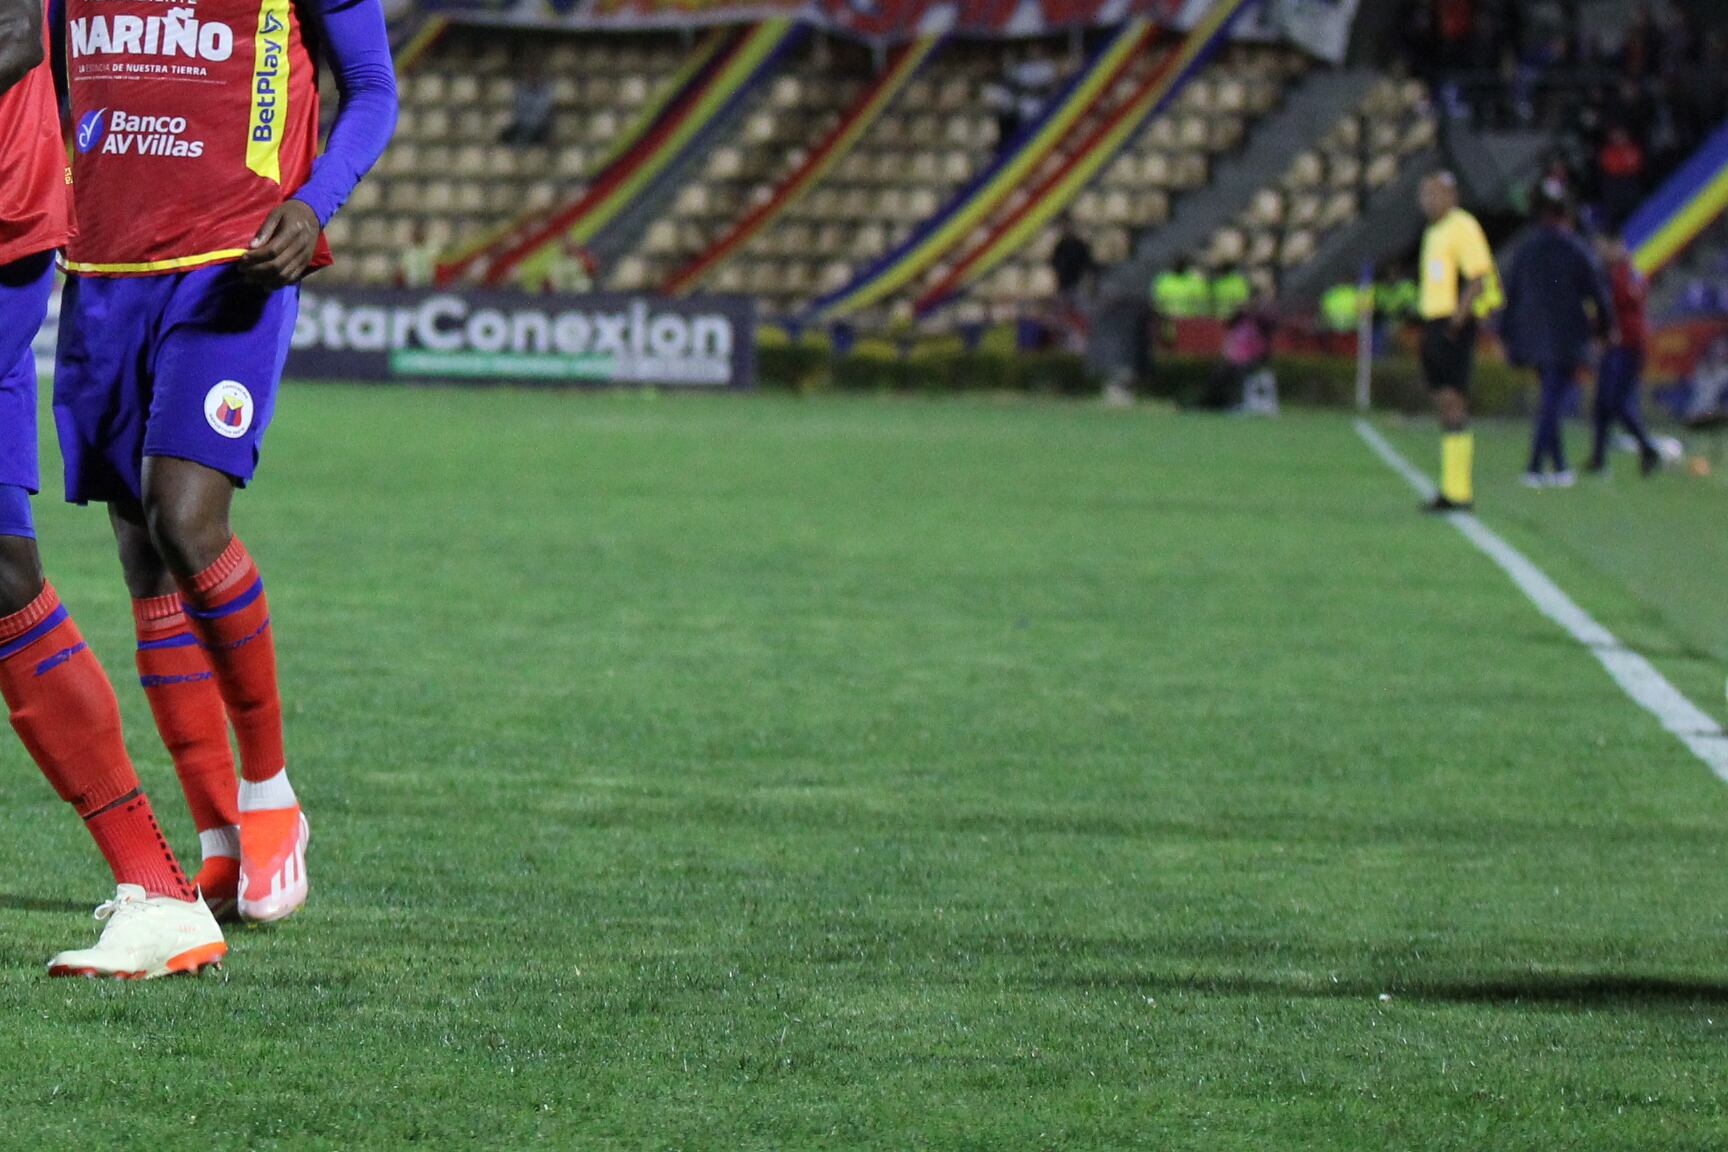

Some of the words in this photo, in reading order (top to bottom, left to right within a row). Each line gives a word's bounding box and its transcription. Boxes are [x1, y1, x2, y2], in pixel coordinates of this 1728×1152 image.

[69, 6, 234, 62] NARIÑO
[112, 63, 124, 73] DE
[126, 64, 168, 74] NUESTRA
[171, 65, 208, 77] TIERRA
[252, 38, 282, 142] BetPlay
[110, 110, 187, 134] Banco
[100, 133, 135, 155] AV
[135, 134, 204, 158] Villas
